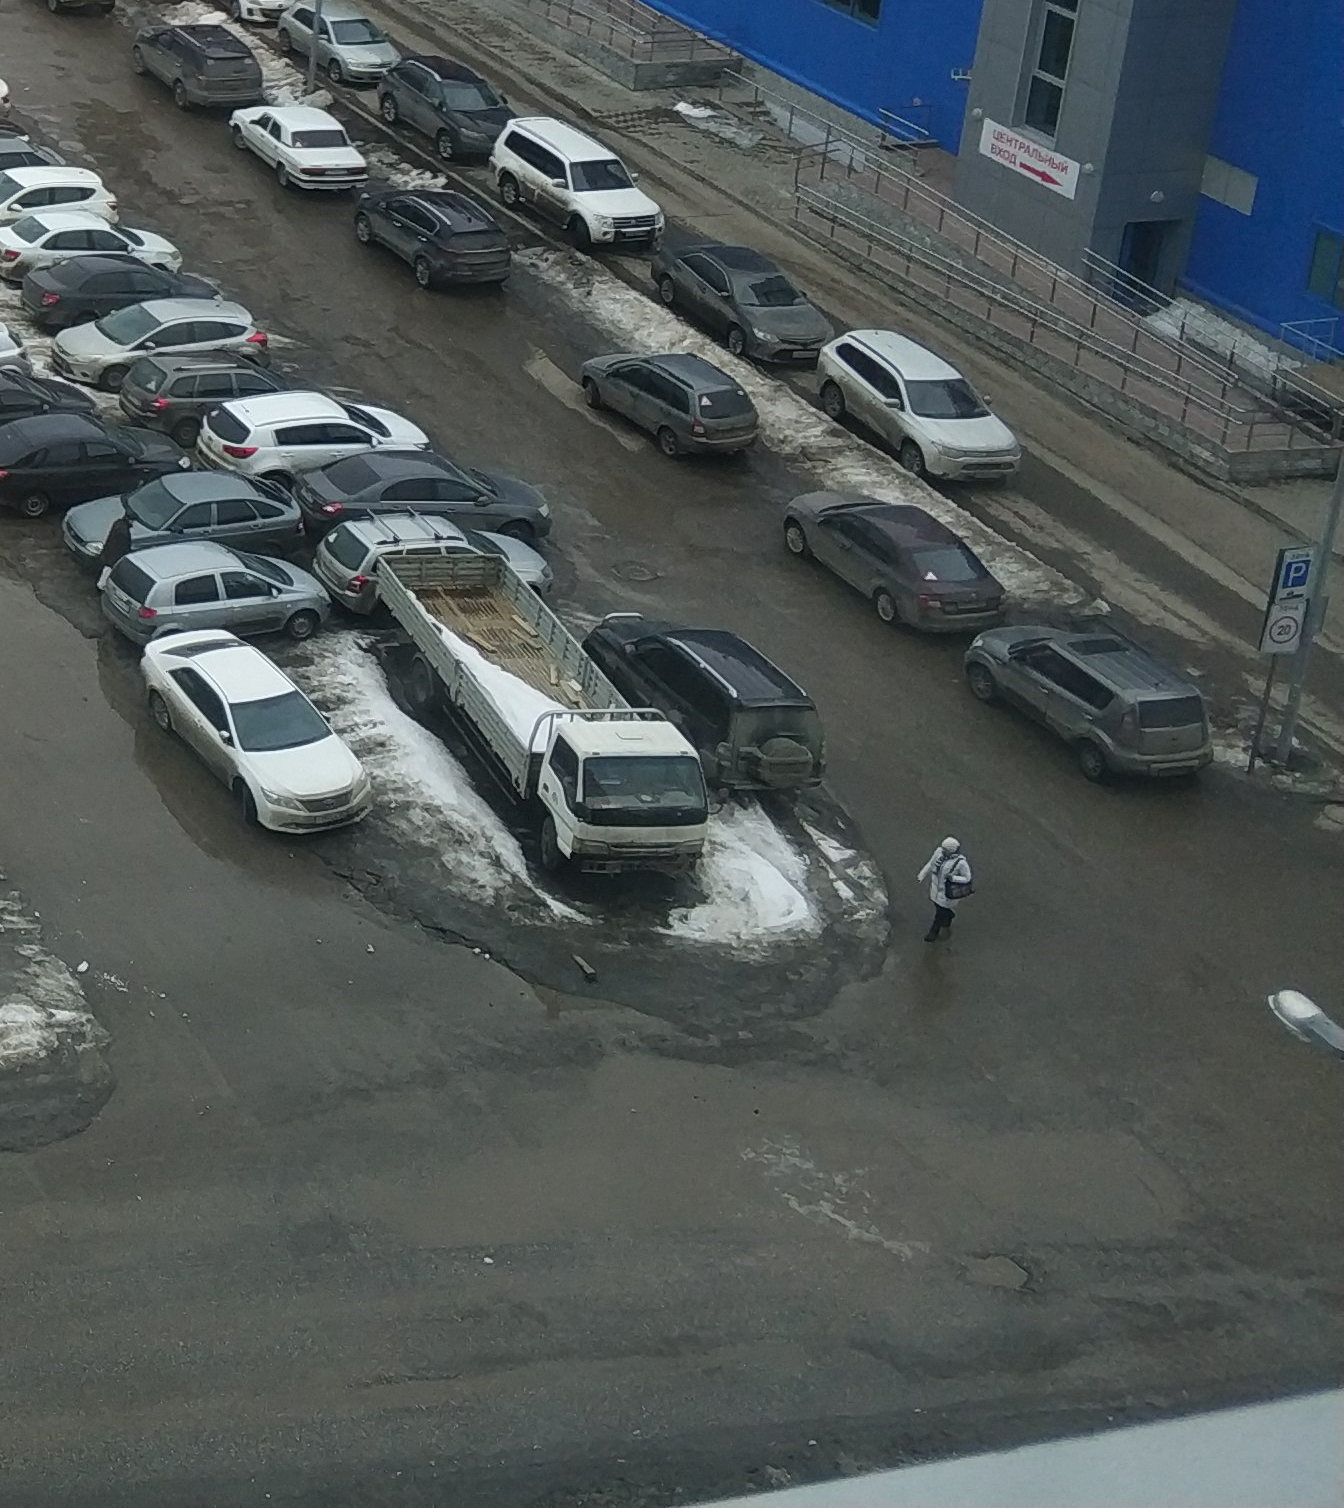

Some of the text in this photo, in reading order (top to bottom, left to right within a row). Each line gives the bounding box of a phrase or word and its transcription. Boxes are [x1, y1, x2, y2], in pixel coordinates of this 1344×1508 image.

[990, 142, 1018, 166] ВХОД
[992, 129, 1069, 175] ЦЕНТРАЛЬНЫЙ
[1287, 562, 1307, 587] P
[1276, 624, 1292, 636] 20
